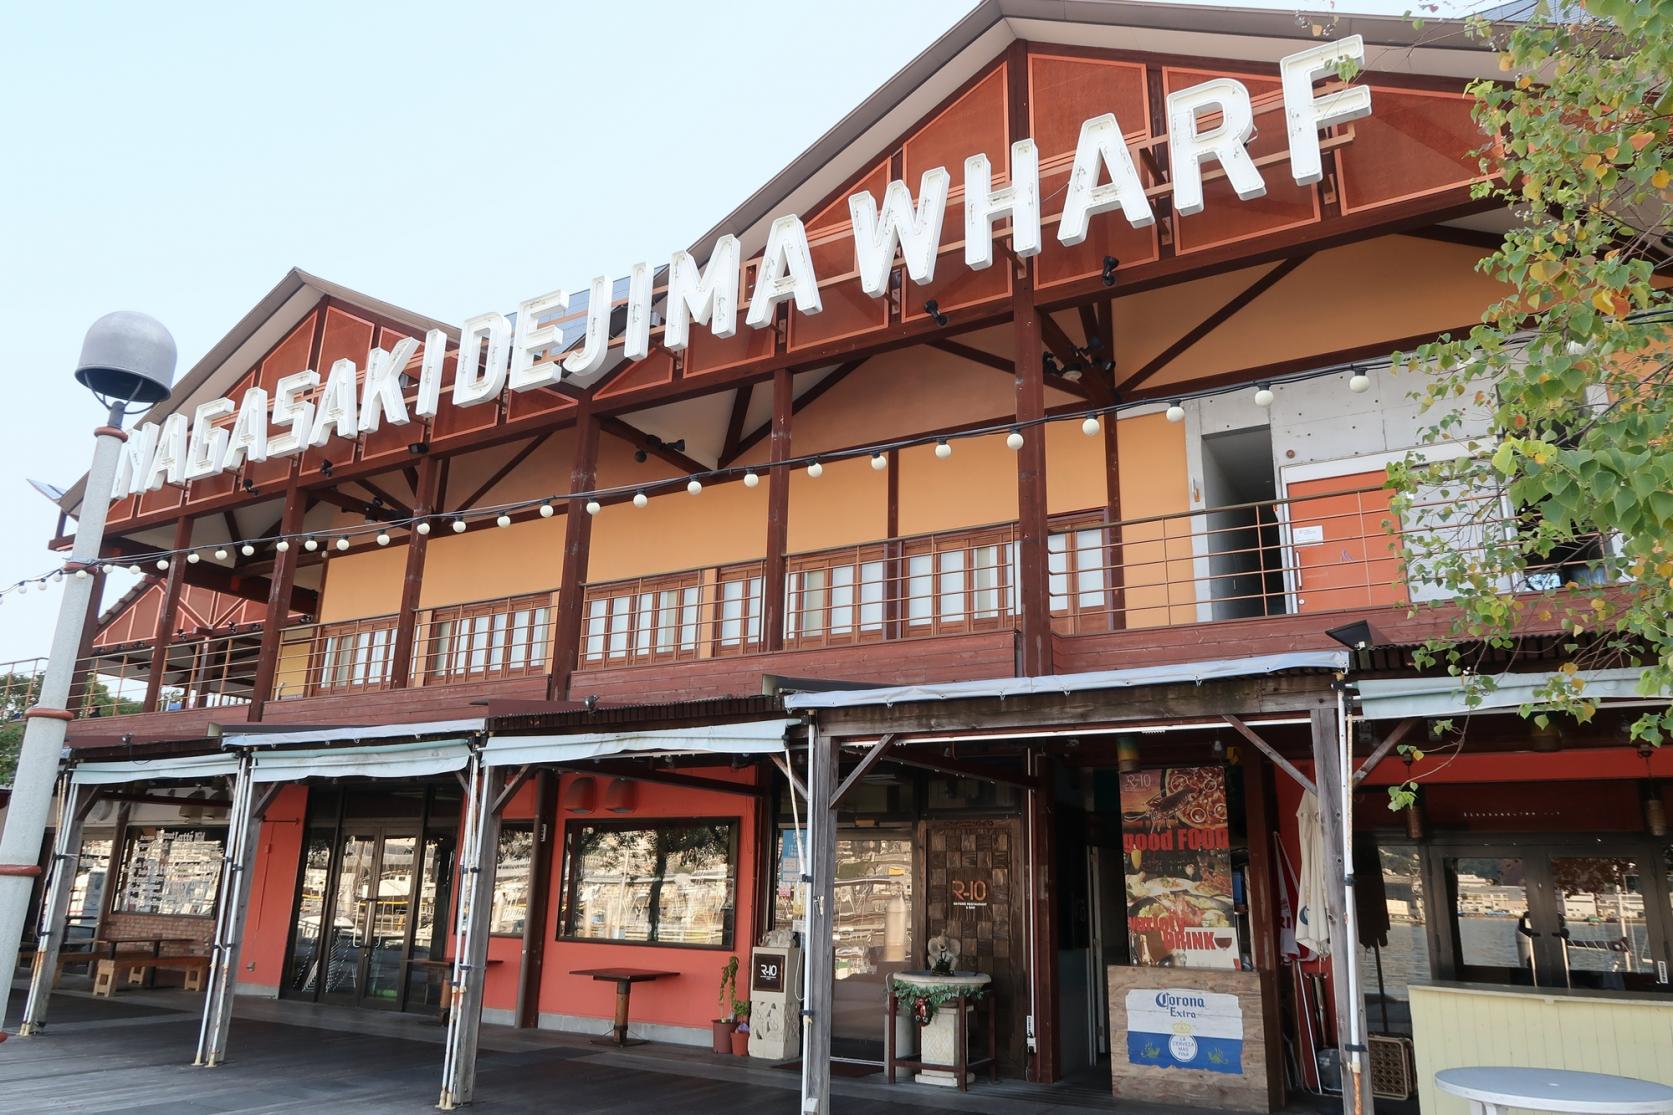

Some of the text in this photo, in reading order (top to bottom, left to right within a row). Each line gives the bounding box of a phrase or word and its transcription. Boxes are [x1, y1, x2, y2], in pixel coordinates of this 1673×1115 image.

[111, 33, 1372, 500] NAGASAKI DEJIMA WHARF
[1123, 827, 1230, 854] good FOOD
[952, 880, 987, 901] R-10
[1162, 930, 1216, 951] DRINK
[1155, 991, 1205, 1010] Corona
[1170, 1007, 1197, 1018] Extra
